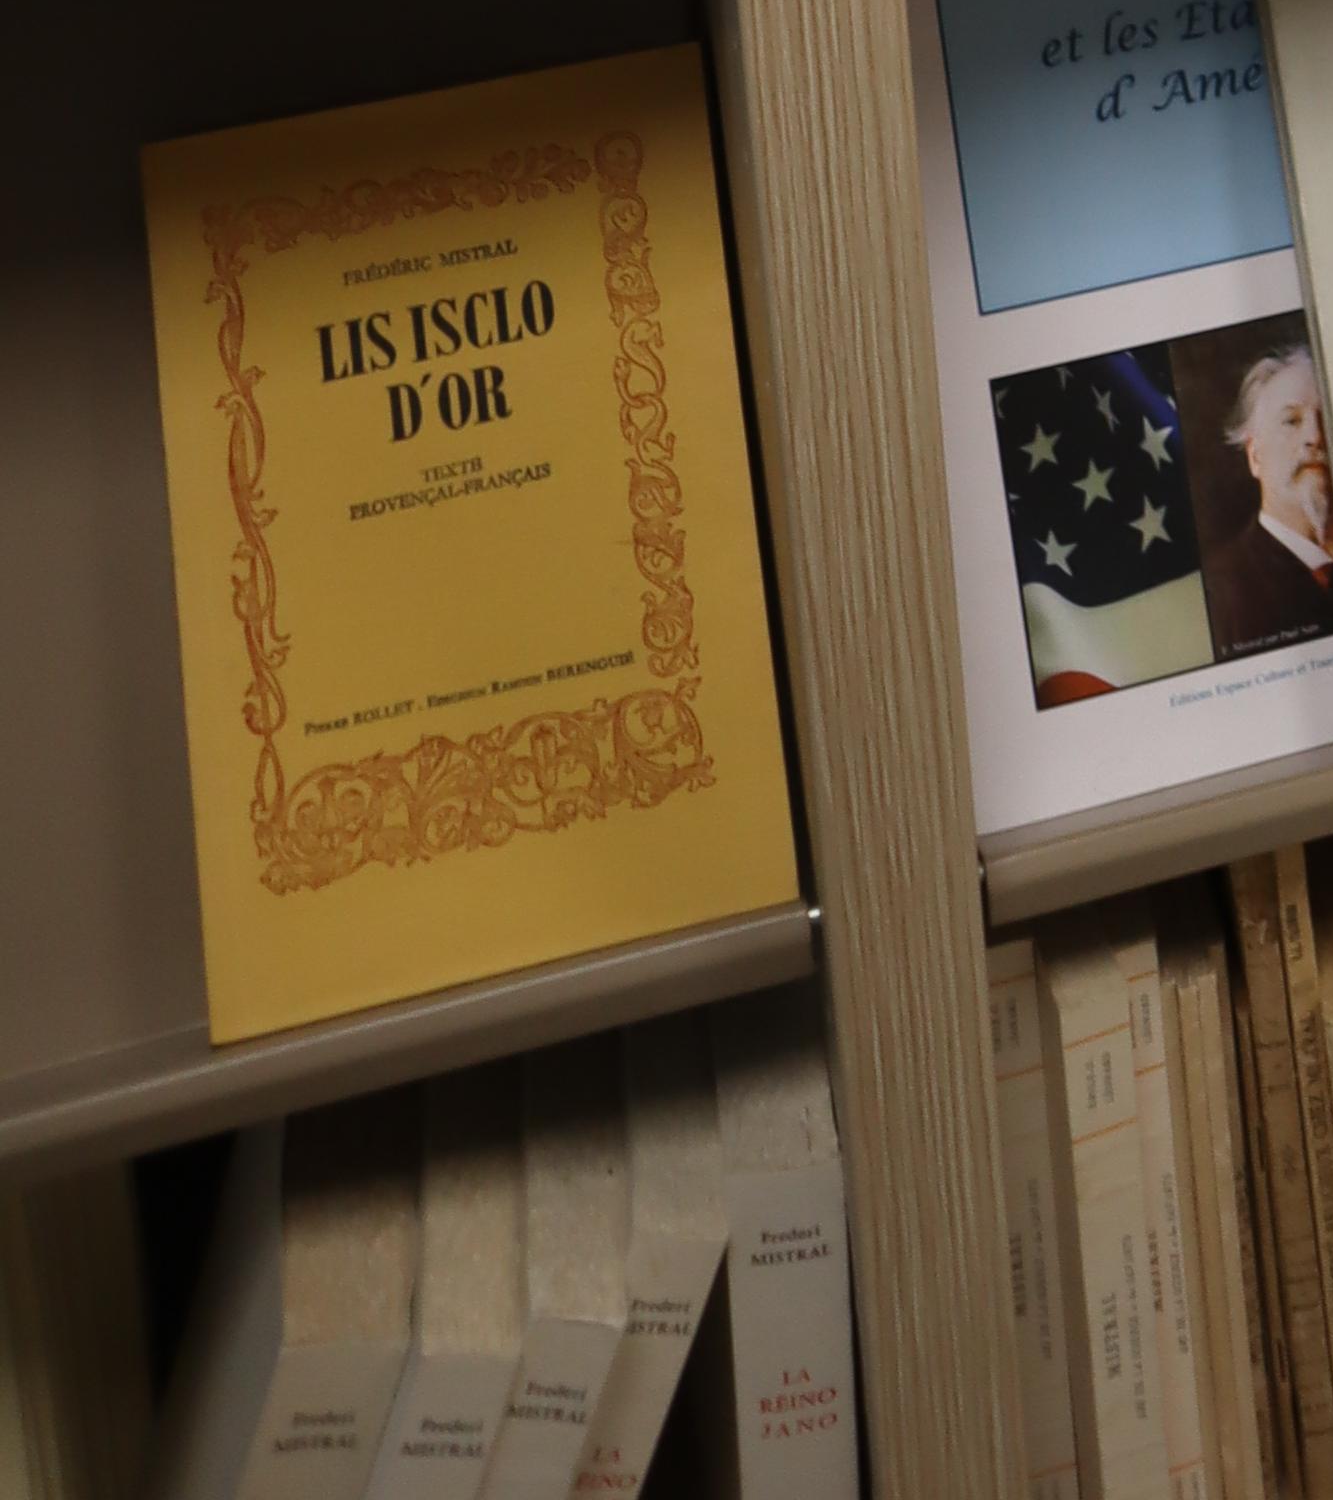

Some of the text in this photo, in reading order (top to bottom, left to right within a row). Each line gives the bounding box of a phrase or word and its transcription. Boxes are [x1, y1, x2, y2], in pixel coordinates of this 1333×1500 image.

[342, 238, 518, 286] FRÉDÉRIC MISTRAL
[315, 279, 556, 383] LIS ISCLO
[749, 1244, 834, 1268] MISTRAL
